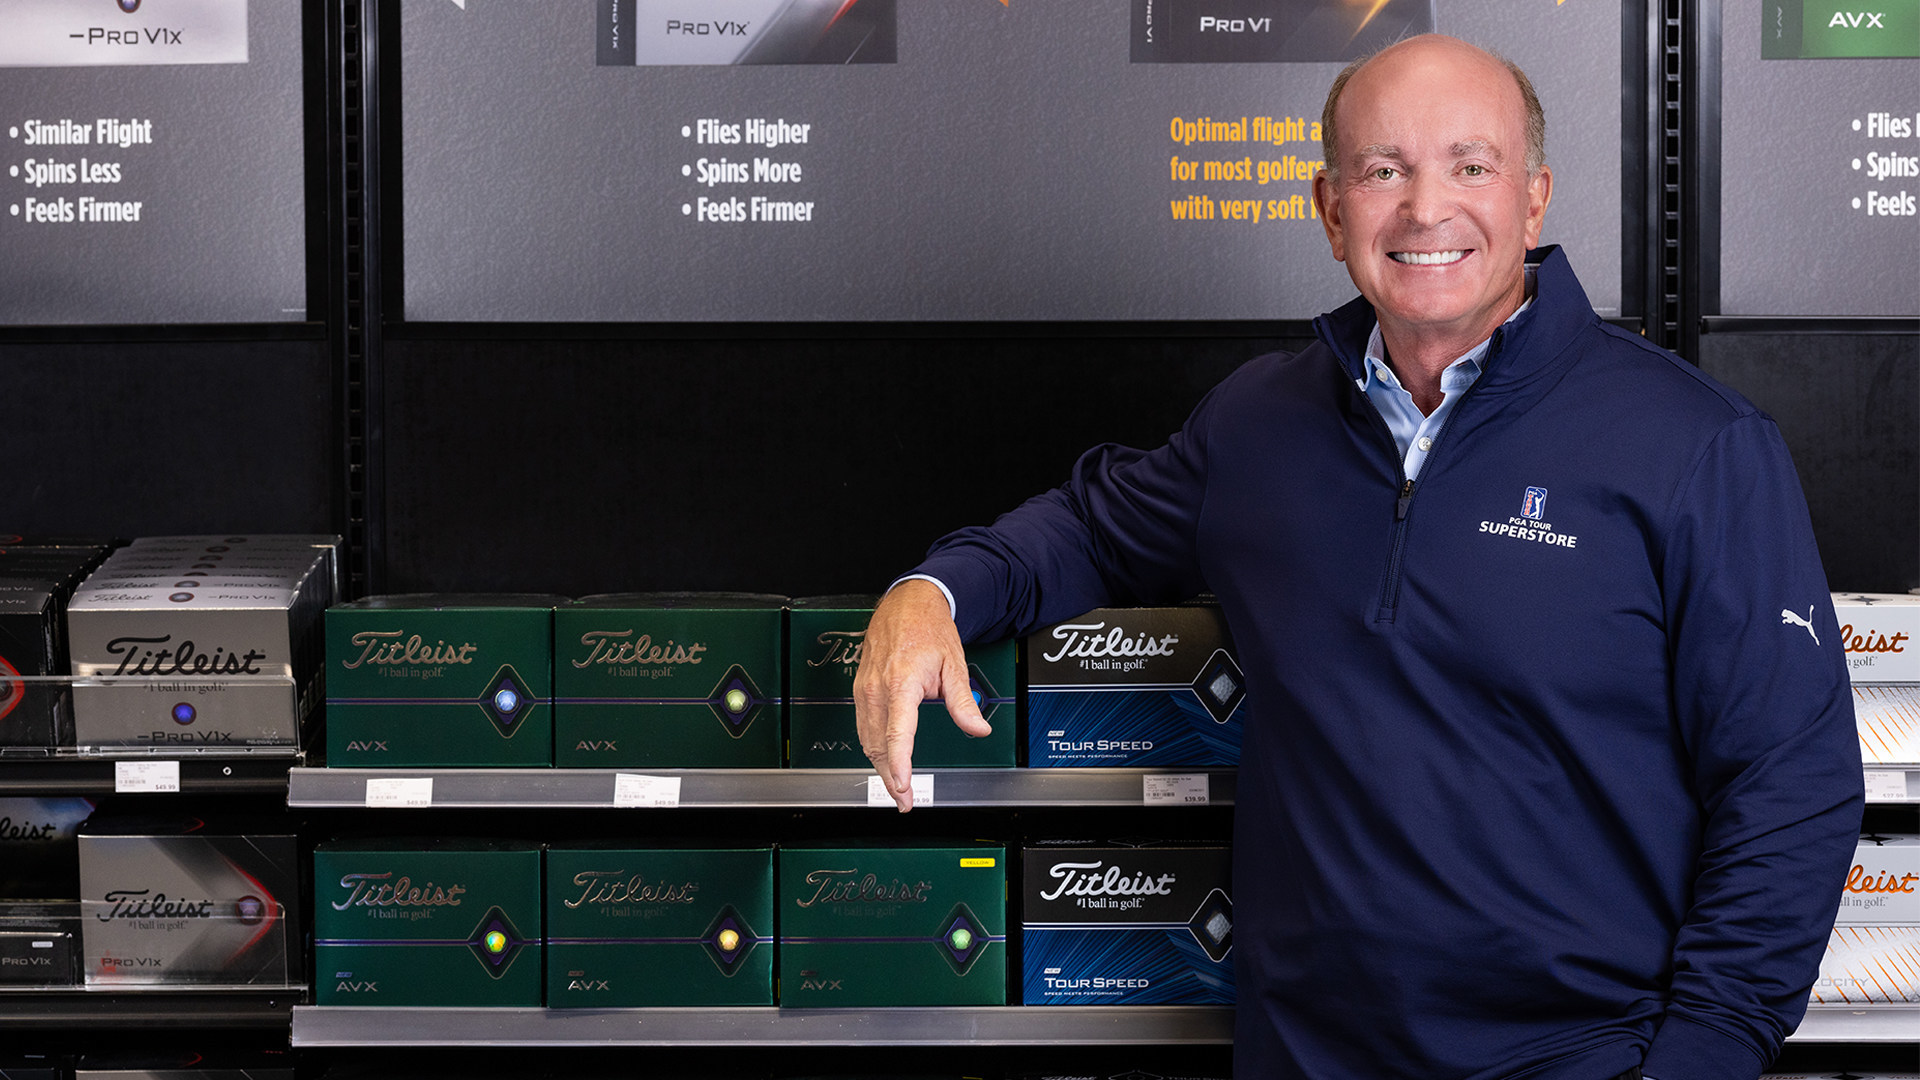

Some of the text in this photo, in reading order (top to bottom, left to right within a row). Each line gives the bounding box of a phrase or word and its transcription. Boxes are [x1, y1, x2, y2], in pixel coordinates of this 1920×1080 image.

[1248, 18, 1270, 33] V1
[1828, 12, 1884, 29] AVX
[24, 118, 152, 148] Similar Flight
[697, 118, 810, 148] Flies Higher
[1170, 117, 1247, 146] Optimal
[1252, 117, 1306, 145] flight
[1868, 113, 1912, 138] Flies
[24, 158, 122, 188] Spins Less
[697, 158, 802, 187] Spins More
[1170, 156, 1198, 181] for
[1204, 157, 1252, 181] most
[1867, 151, 1919, 181] Spins
[25, 196, 142, 223] Feels Firmer
[698, 196, 814, 222] Feels Firmer
[1171, 195, 1214, 220] with
[1220, 200, 1262, 224] very
[1267, 195, 1305, 220] soft
[1867, 191, 1917, 216] Feels
[1479, 521, 1578, 548] SUPERSTORE
[1509, 517, 1552, 531] PGA TOUR
[342, 630, 477, 669] Titleist
[572, 629, 707, 668] Titleist
[1043, 621, 1179, 662] Titleist
[1840, 624, 1909, 653] leist
[96, 634, 266, 684] Titleist
[390, 667, 408, 677] ball
[410, 667, 420, 677] in
[619, 667, 637, 677] ball
[640, 667, 649, 677] in
[1091, 659, 1109, 670] ball
[1112, 659, 1121, 670] in
[346, 741, 388, 751] AVX
[575, 740, 617, 751] AVX
[810, 741, 852, 751] AVX
[331, 872, 466, 911] Titleist
[564, 869, 699, 909] Titleist
[796, 868, 932, 907] Titleist
[1040, 860, 1176, 901] Titleist
[1843, 864, 1920, 894] leist
[97, 889, 214, 922] Titleist
[379, 909, 397, 919] ball
[400, 909, 409, 919] in
[1088, 898, 1107, 908] ball
[1109, 898, 1118, 908] in
[1852, 897, 1862, 907] in
[336, 981, 378, 992] AVX
[568, 980, 609, 990] AVX
[800, 980, 842, 990] AVX
